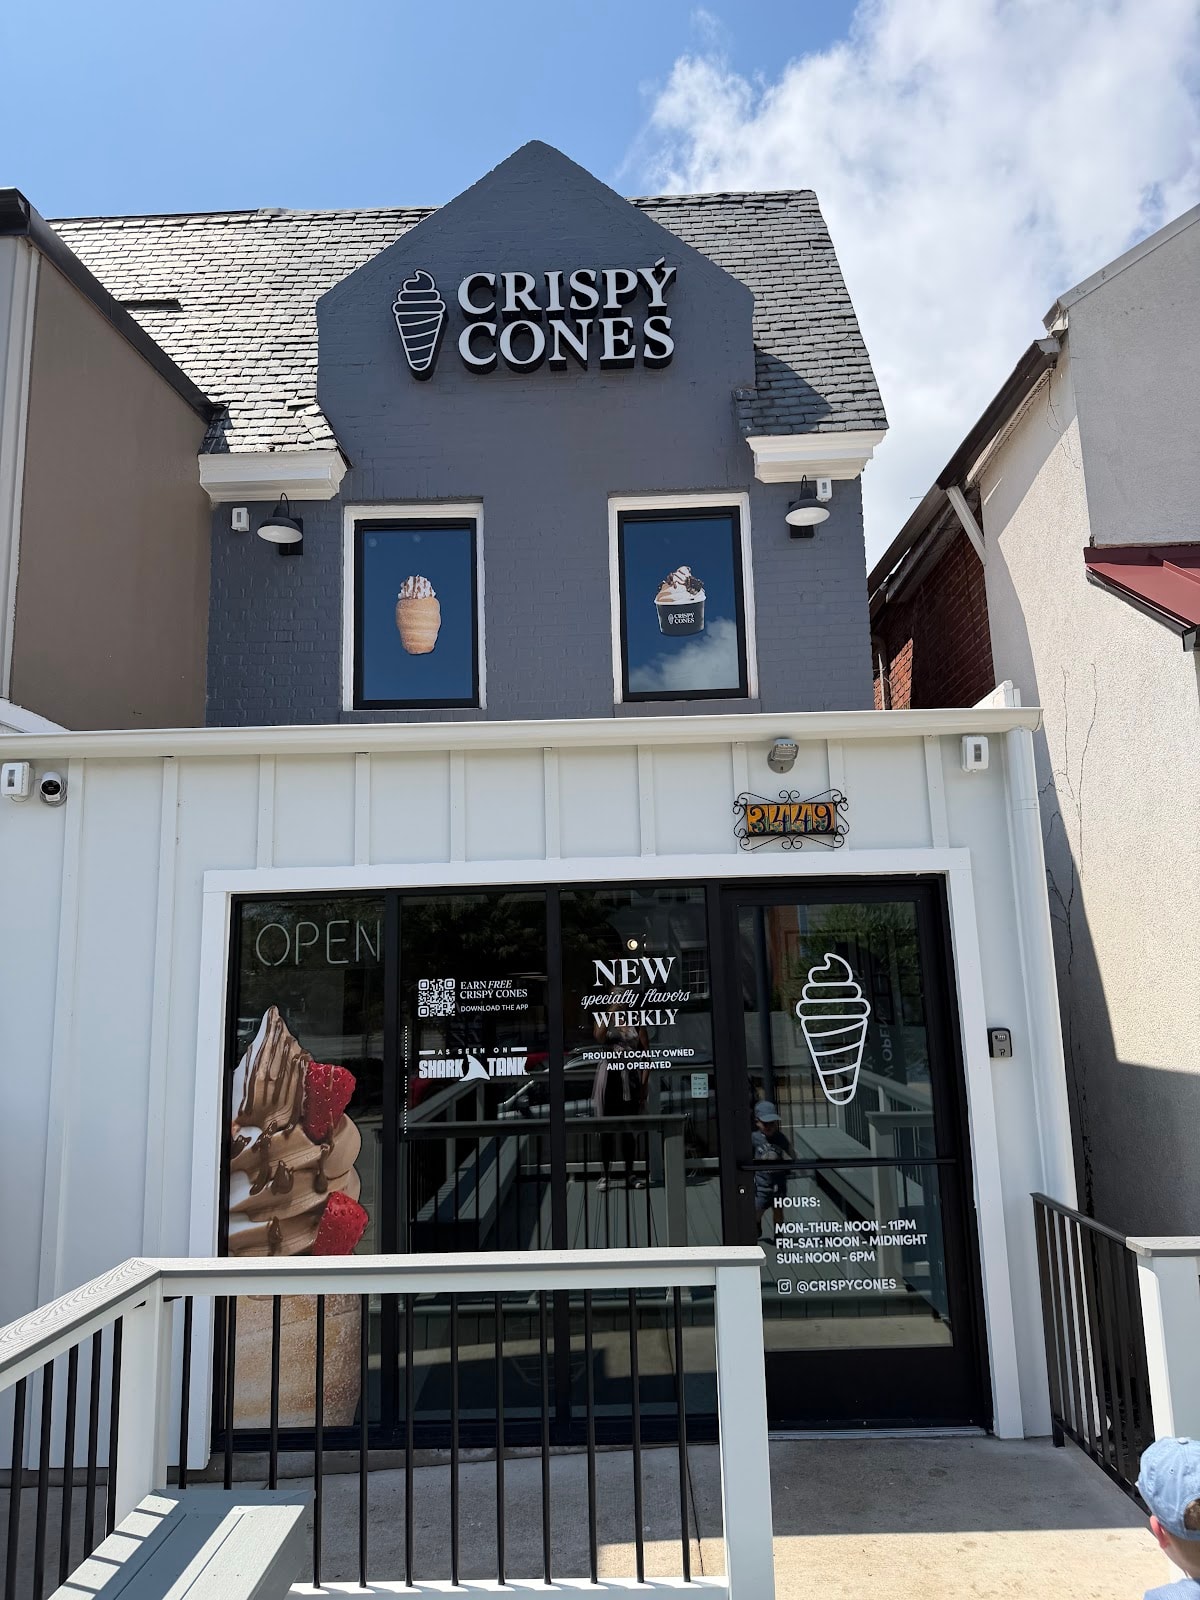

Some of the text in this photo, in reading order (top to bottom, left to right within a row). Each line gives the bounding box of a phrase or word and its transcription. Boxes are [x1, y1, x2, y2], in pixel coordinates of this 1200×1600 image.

[458, 316, 675, 368] CONES
[750, 804, 833, 833] 3449
[256, 920, 381, 966] OPEN
[592, 957, 676, 987] NEW
[460, 980, 512, 990] EARN FREE
[495, 989, 528, 998] CONES
[581, 988, 691, 1010] specialty flavors
[592, 1008, 679, 1028] WEEKLY
[583, 1048, 695, 1060] PROUDLY LOCALLY OWNED
[419, 1057, 530, 1079] SHARK TANK
[606, 1061, 672, 1071] AND OPERATED
[773, 1197, 821, 1208] HOURS:
[775, 1222, 843, 1234] MON-THUR:
[844, 1220, 879, 1233] NOON
[888, 1219, 917, 1231] 11PM
[776, 1236, 824, 1249] FRI-SAT:
[825, 1236, 860, 1248] NOON
[869, 1234, 928, 1246] MIDNIGHT
[776, 1253, 803, 1264] SUN:
[805, 1252, 840, 1264] NOON
[849, 1251, 876, 1262] 6PM
[796, 1278, 897, 1294] @CRISPYCONES
